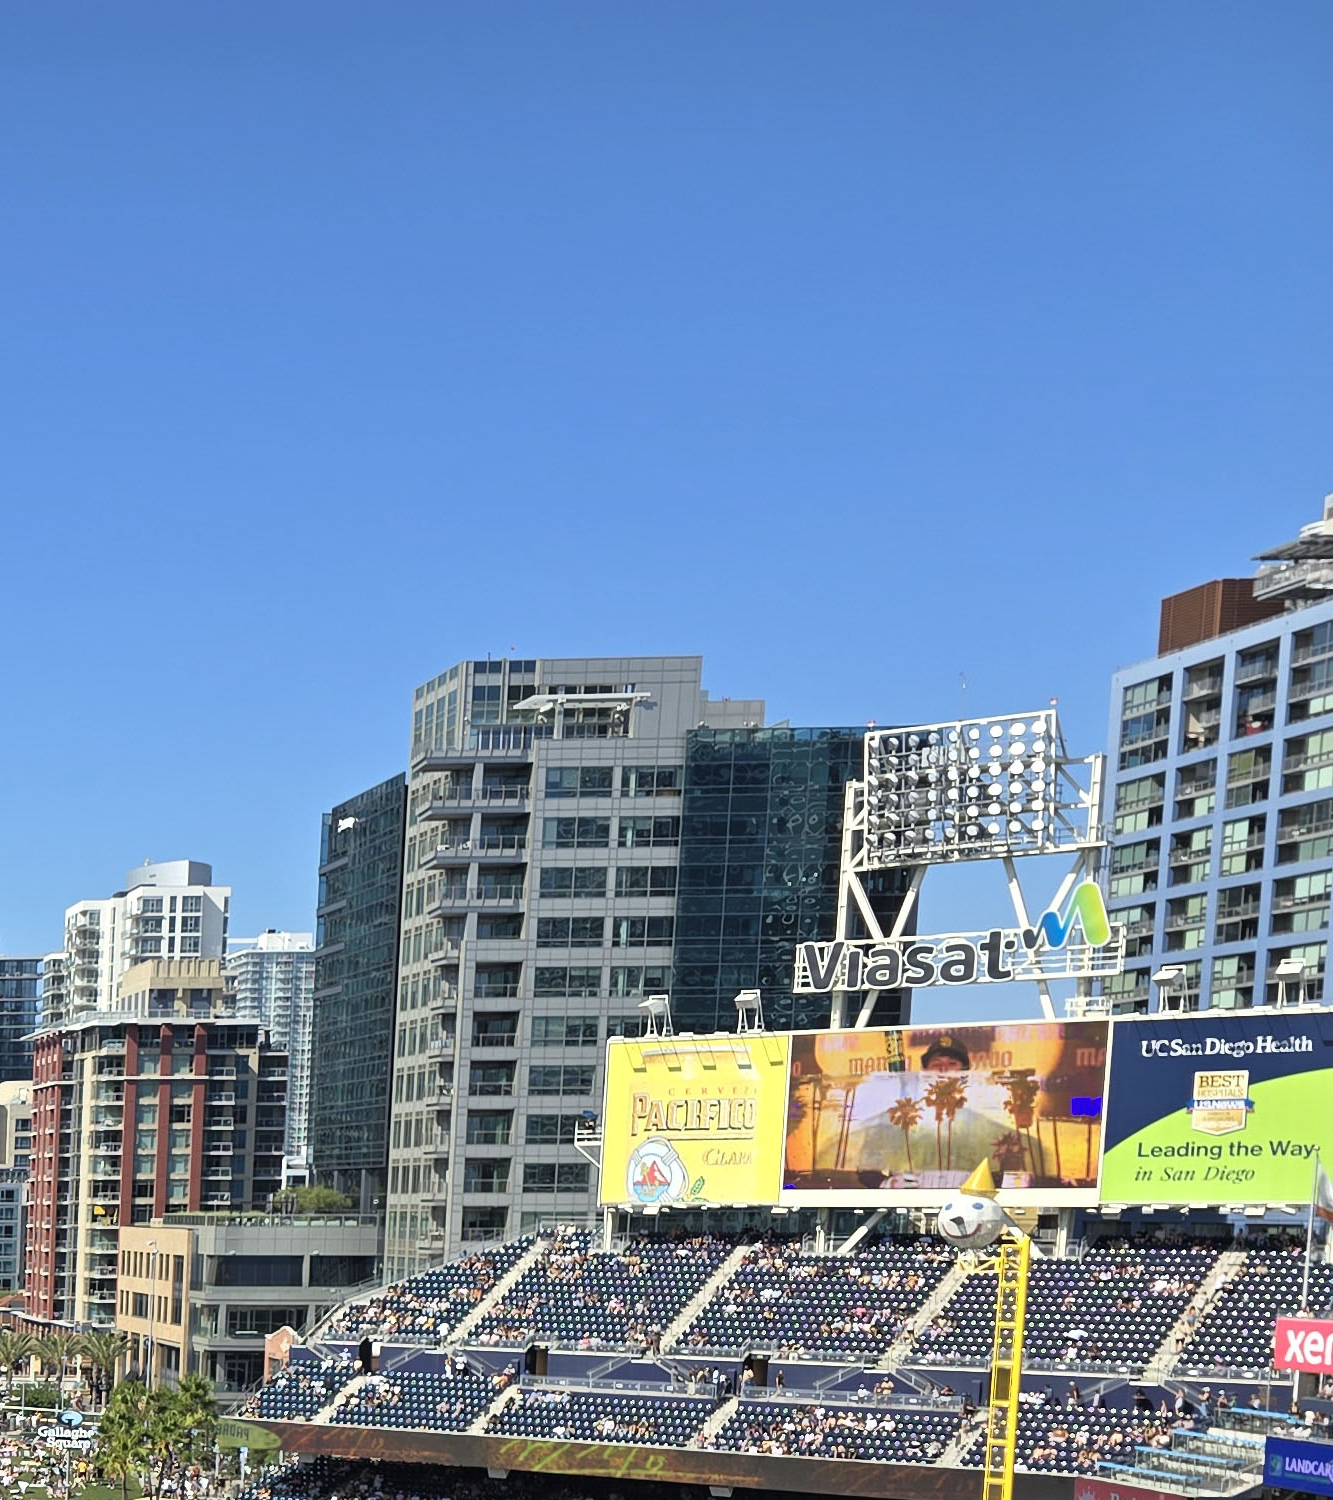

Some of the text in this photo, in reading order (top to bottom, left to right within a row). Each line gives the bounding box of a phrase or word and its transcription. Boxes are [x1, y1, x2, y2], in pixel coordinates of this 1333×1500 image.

[804, 931, 1012, 990] Viasat
[1141, 1035, 1313, 1058] UC San Diego Health
[1198, 1074, 1245, 1089] BEST
[631, 1092, 758, 1137] PACIFICO
[1137, 1140, 1316, 1160] Leading the Way
[1135, 1165, 1256, 1184] in San Diego
[45, 1436, 91, 1450] Square
